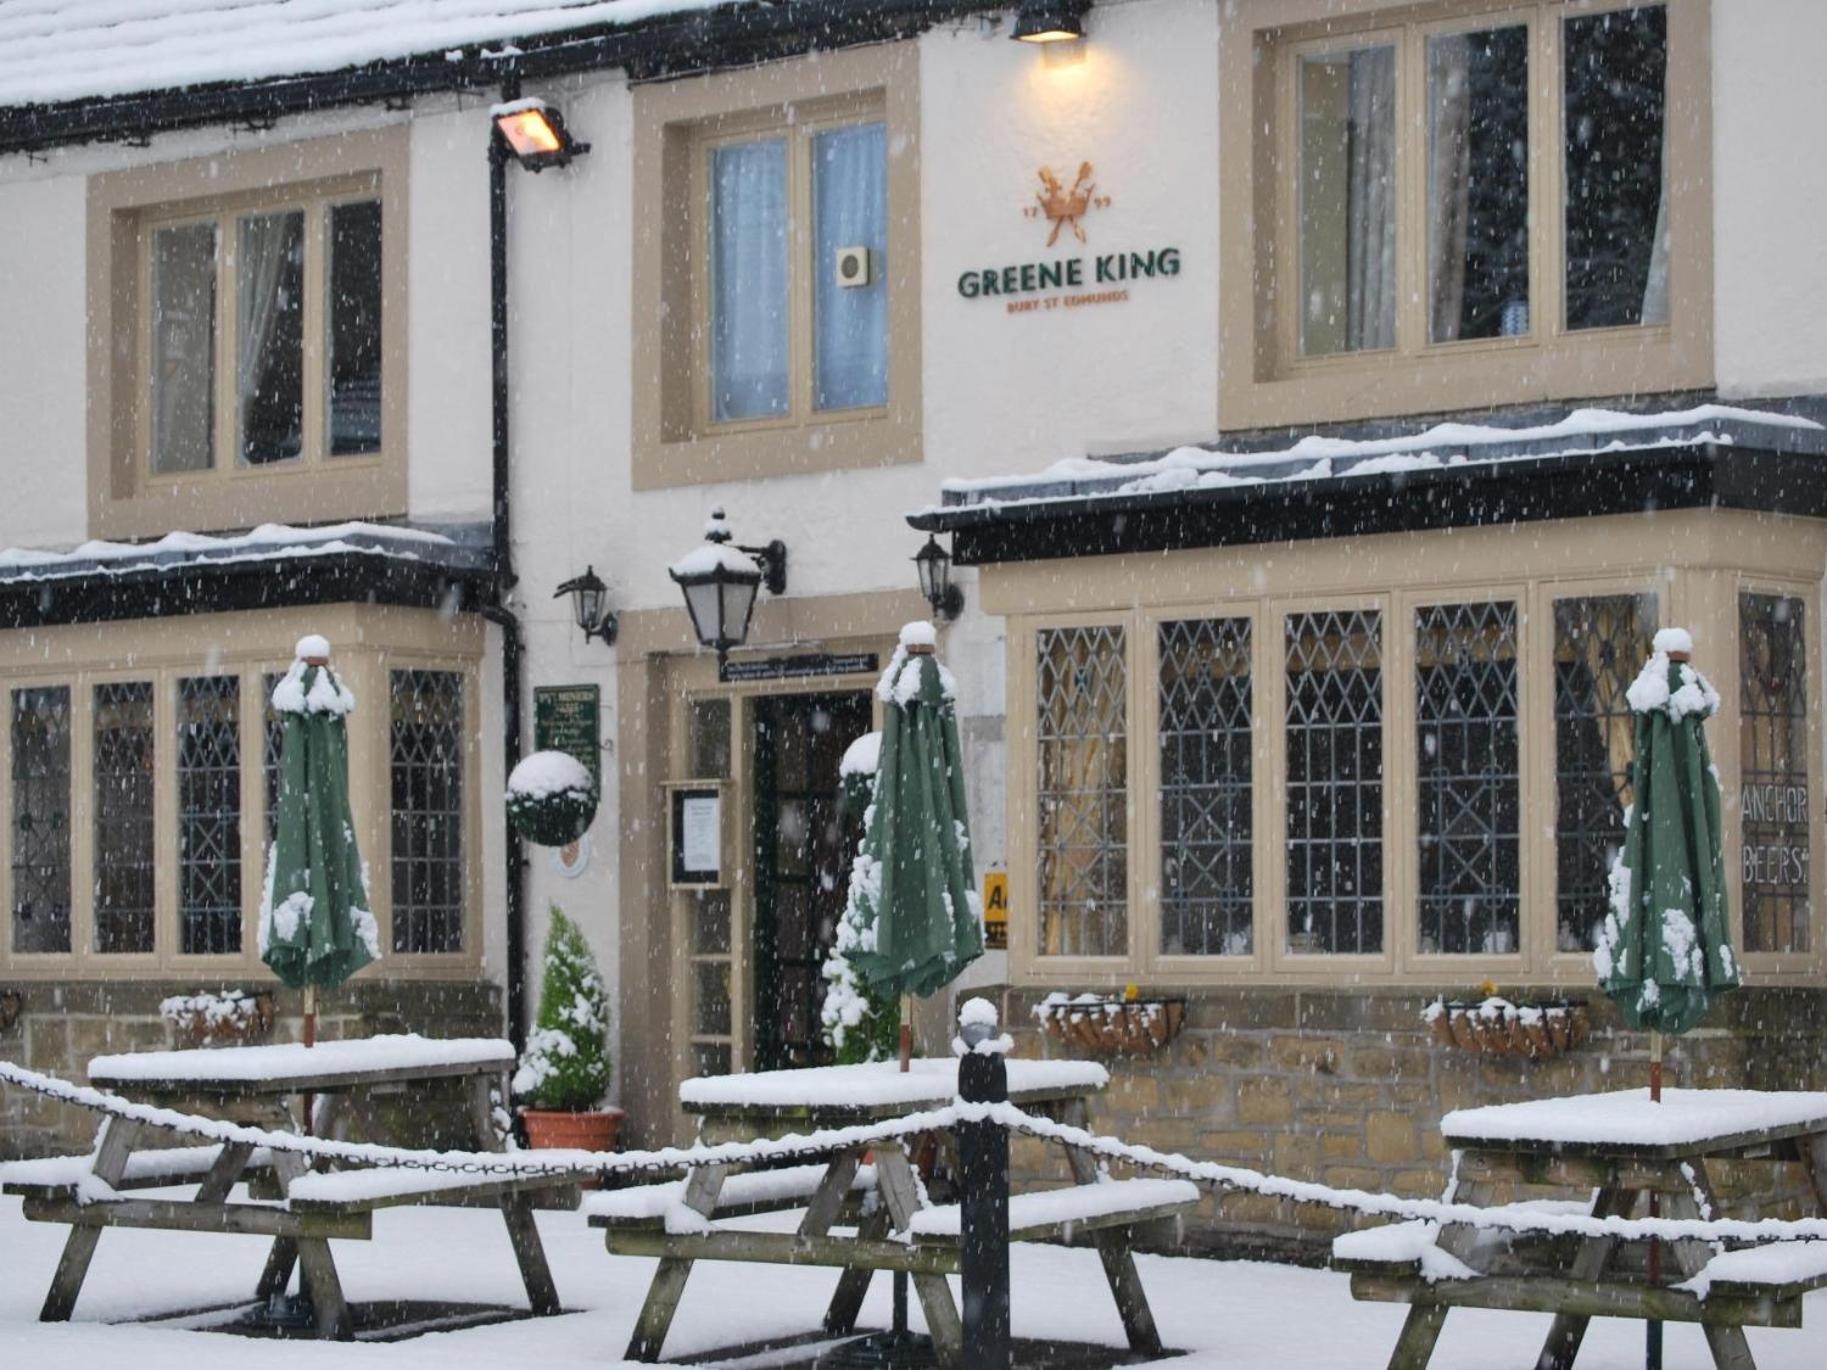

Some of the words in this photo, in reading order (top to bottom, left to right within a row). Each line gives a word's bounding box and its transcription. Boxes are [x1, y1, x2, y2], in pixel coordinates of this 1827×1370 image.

[957, 258, 1083, 299] GREENE
[1096, 247, 1181, 283] KING
[1007, 299, 1040, 314] BURY
[1044, 296, 1058, 309] ST
[1064, 290, 1129, 307] EDMUNDS
[1741, 785, 1807, 823] ANCHOR
